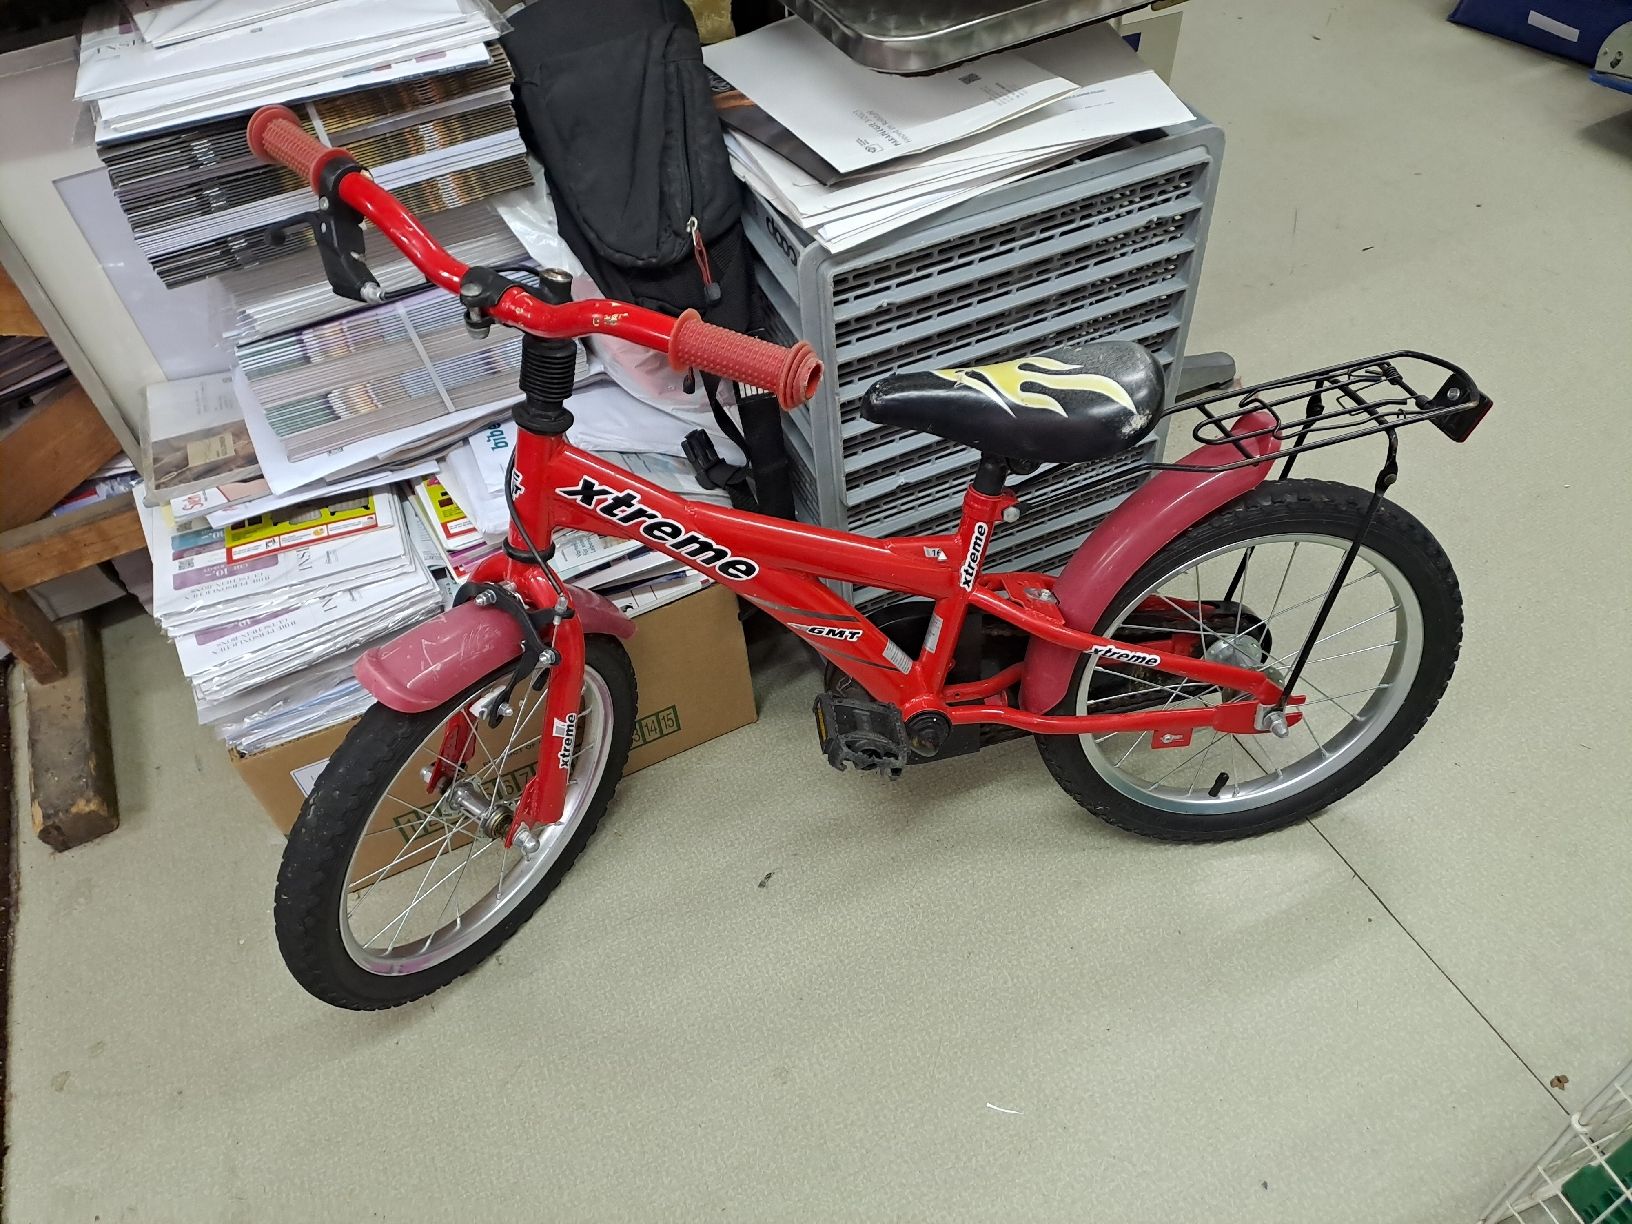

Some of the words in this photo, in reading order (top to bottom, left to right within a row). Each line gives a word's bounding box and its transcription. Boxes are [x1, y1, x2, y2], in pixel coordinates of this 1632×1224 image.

[557, 477, 758, 579] xtreme
[962, 523, 987, 590] xtreme
[808, 626, 862, 641] GMT
[1092, 645, 1160, 667] xtreme
[561, 714, 576, 768] xtreme
[644, 719, 658, 737] 14
[661, 711, 675, 730] 15
